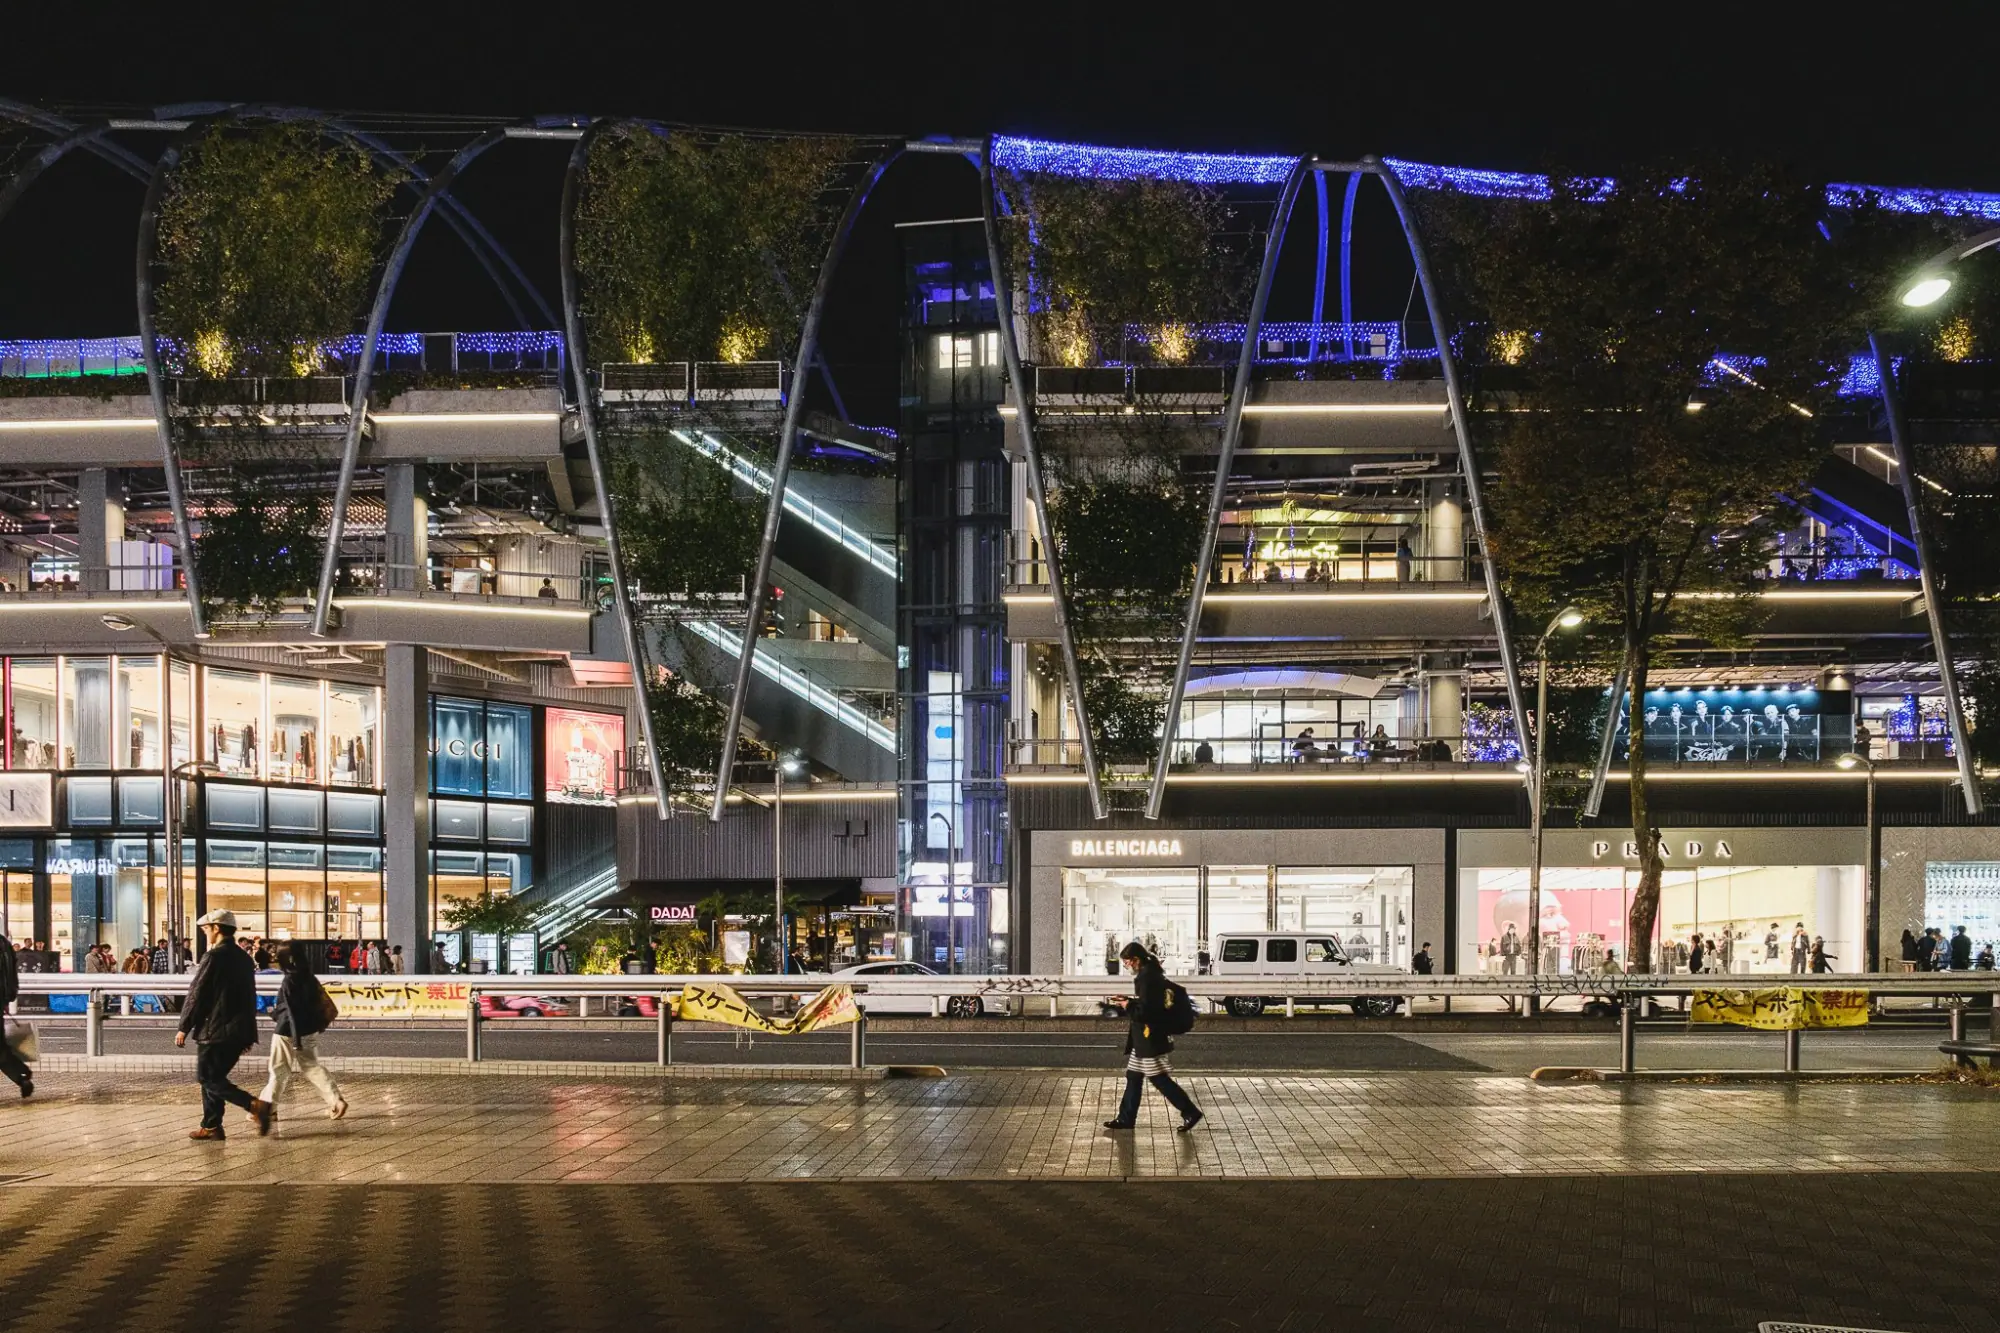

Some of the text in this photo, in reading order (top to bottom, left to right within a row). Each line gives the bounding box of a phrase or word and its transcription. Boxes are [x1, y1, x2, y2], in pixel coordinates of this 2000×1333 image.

[428, 738, 501, 759] UCCI
[1071, 840, 1182, 856] BALENCIAGA
[651, 905, 696, 919] DADAÏ
